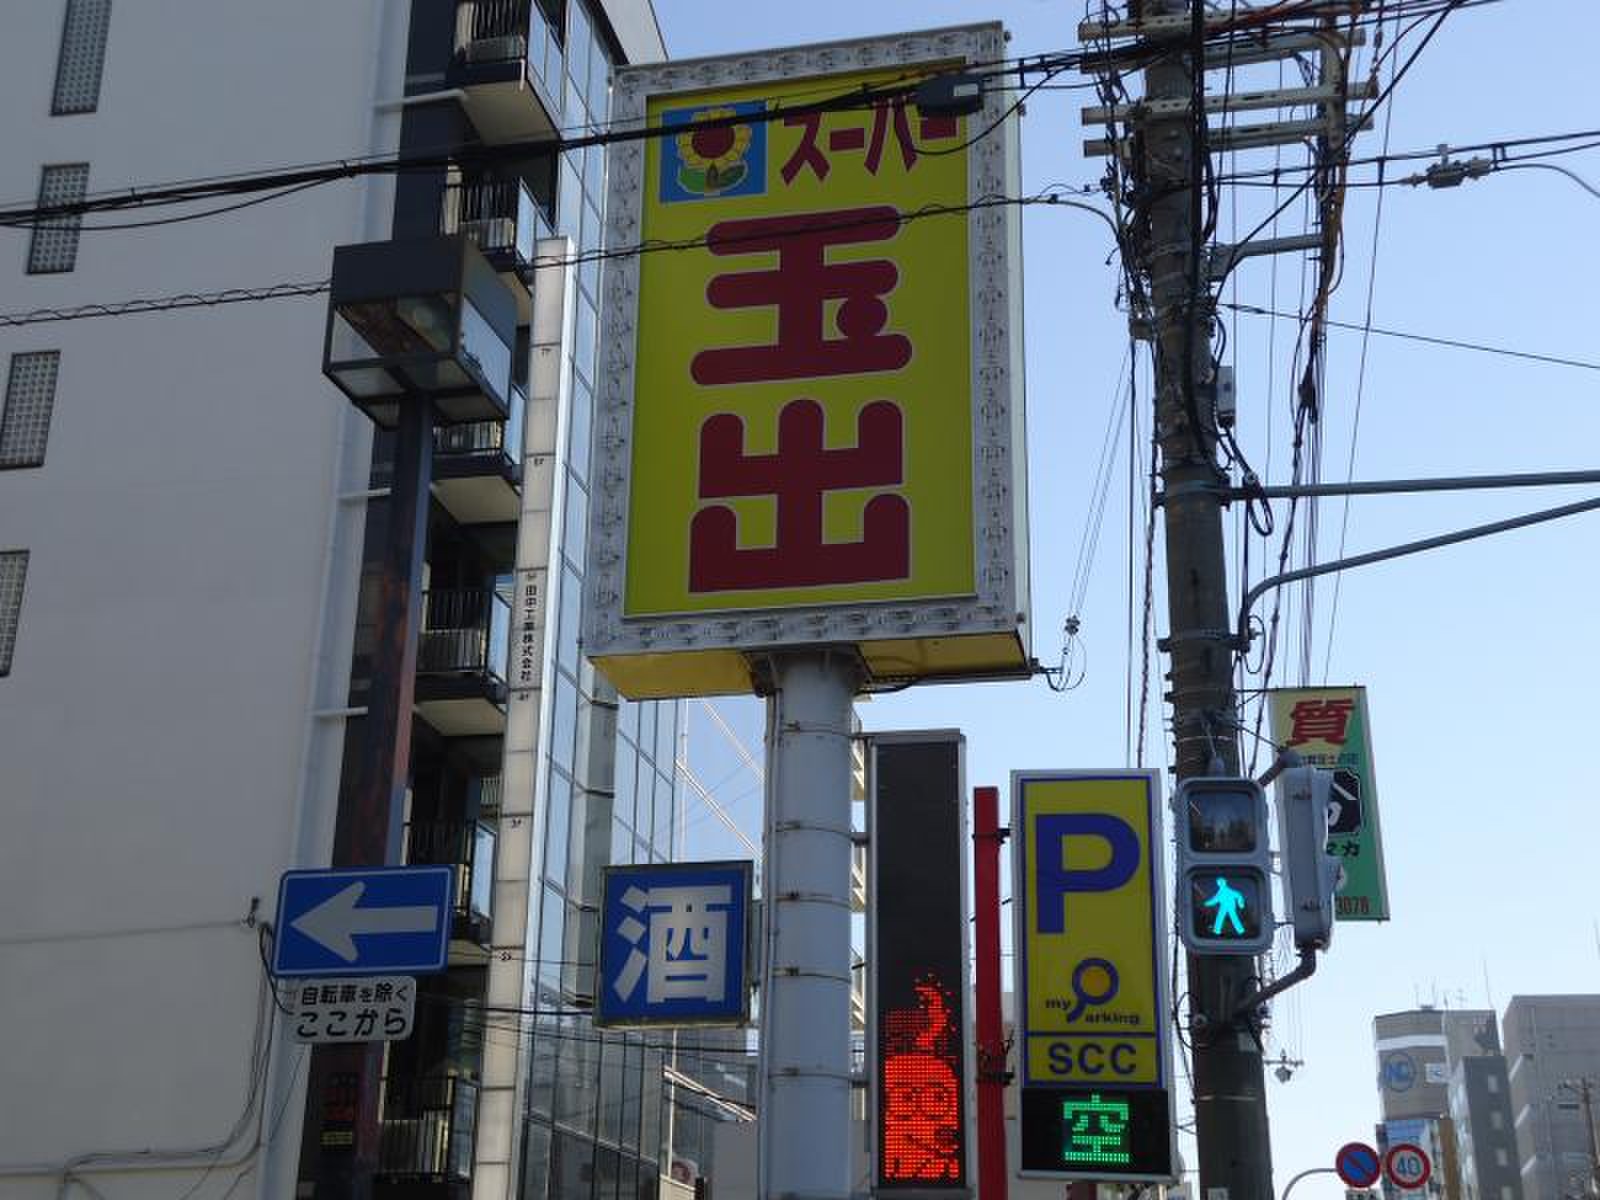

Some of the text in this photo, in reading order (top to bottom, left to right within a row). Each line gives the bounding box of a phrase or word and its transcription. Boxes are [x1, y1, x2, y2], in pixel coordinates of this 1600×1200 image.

[689, 205, 913, 593] 玉出
[1287, 697, 1356, 746] 質
[1035, 813, 1141, 934] P
[613, 885, 732, 1005] 酒
[302, 982, 407, 1005] 自転車を除く
[297, 1008, 407, 1037] ここから
[1048, 1043, 1137, 1075] SCC
[1063, 1095, 1130, 1164] 空
[1397, 1155, 1421, 1177] 40
